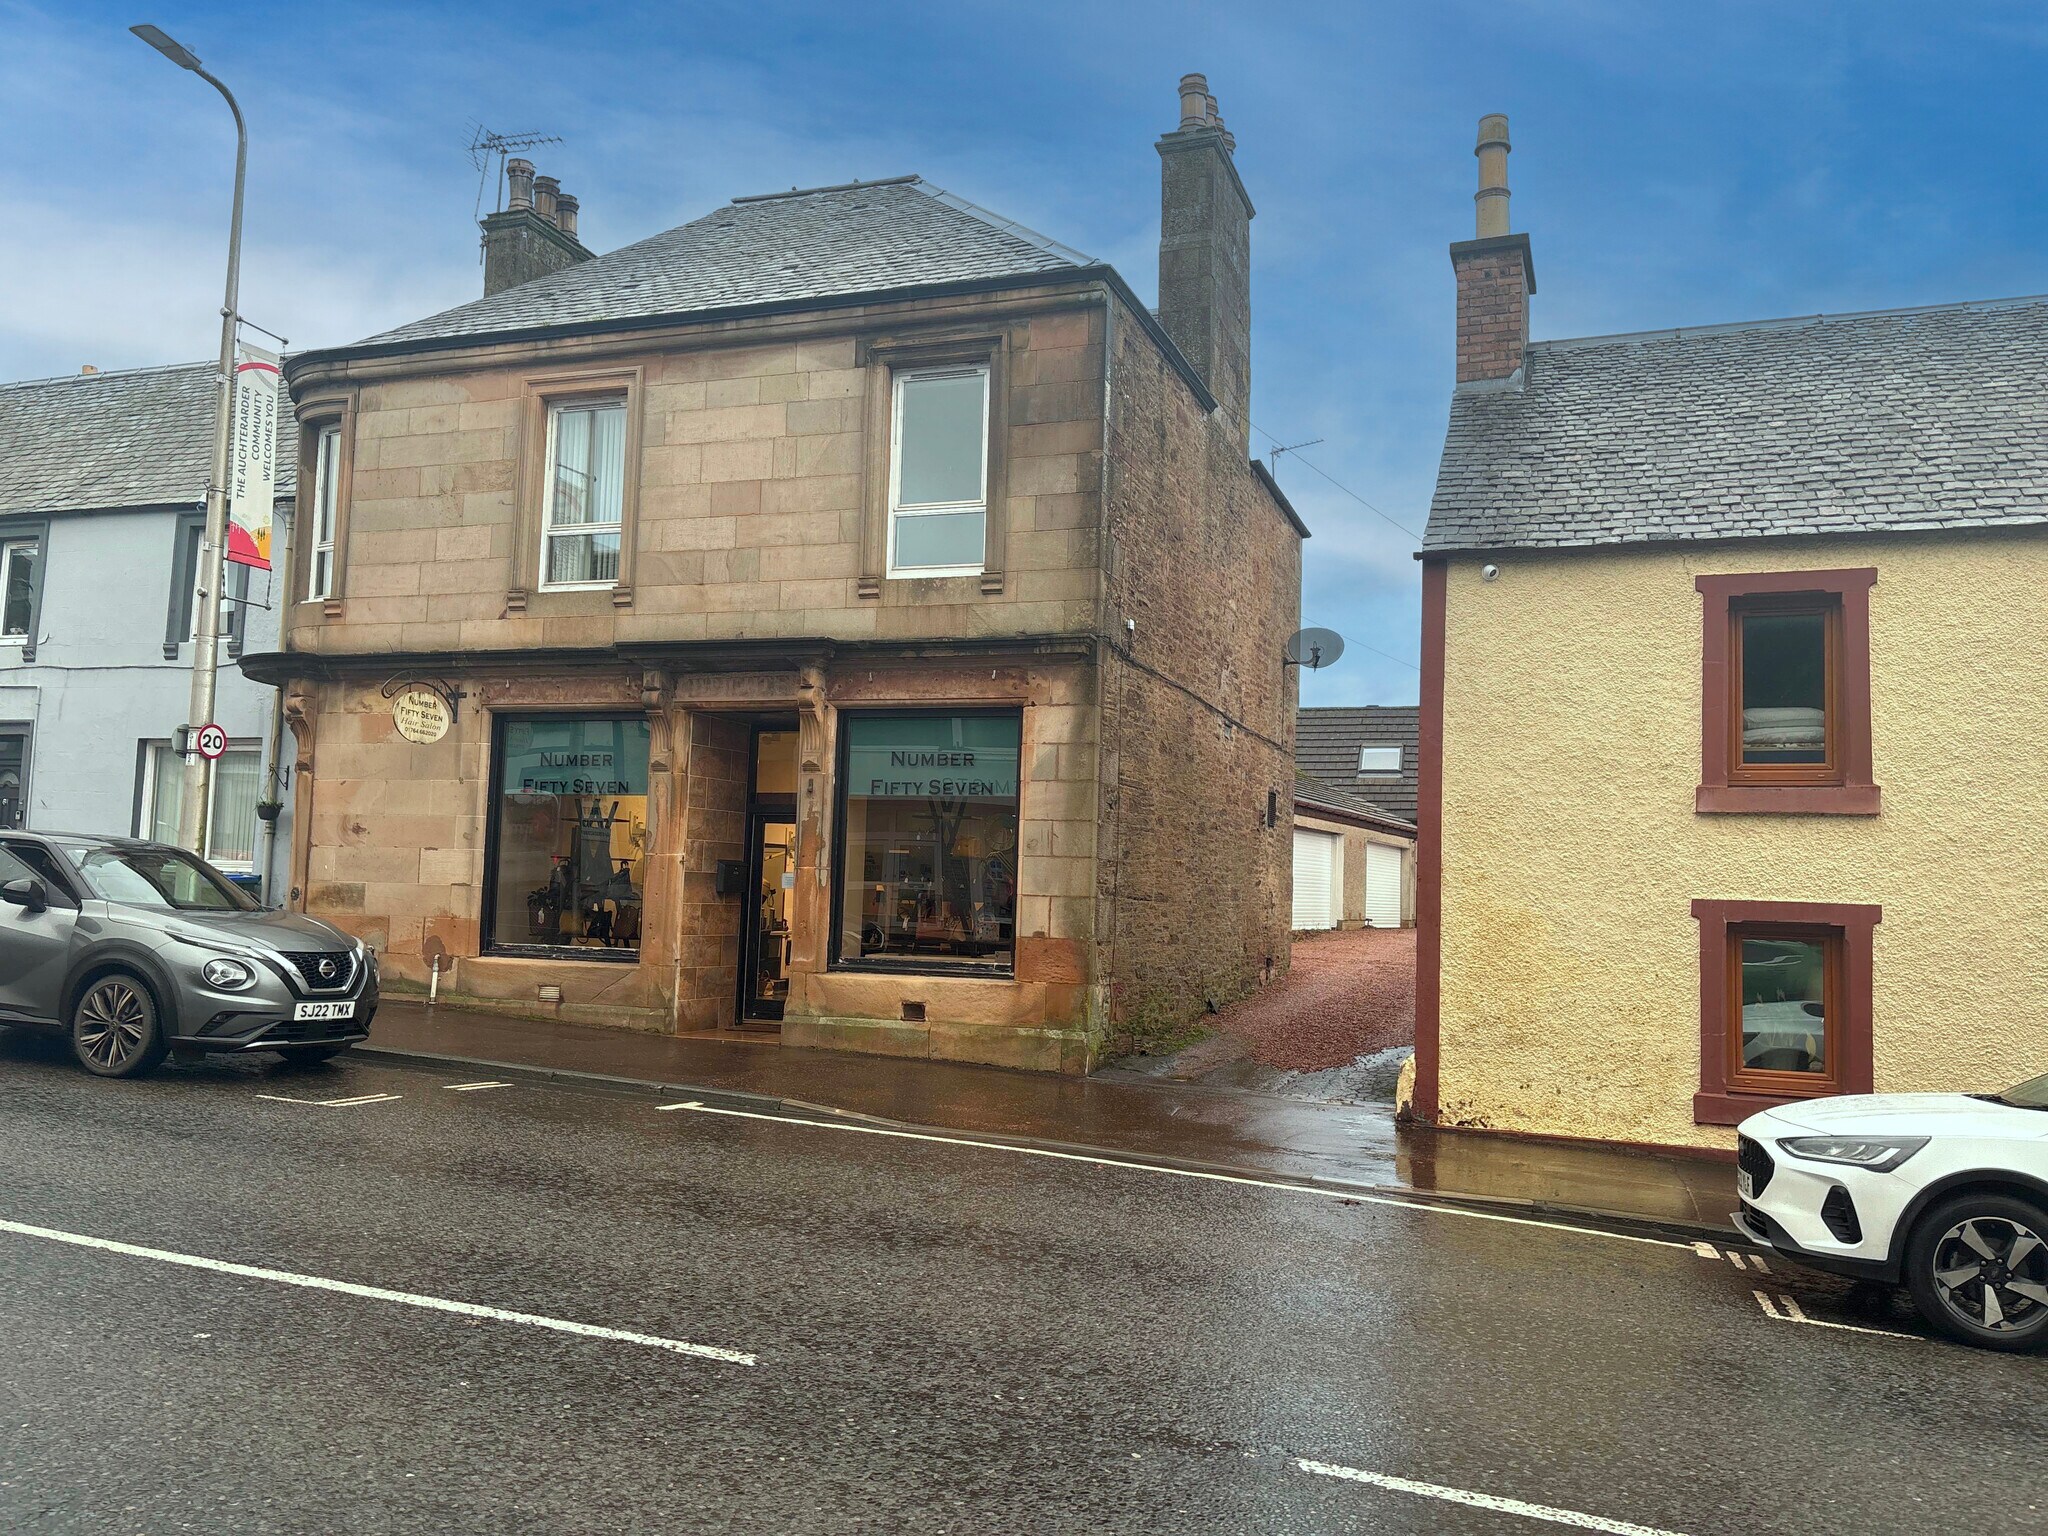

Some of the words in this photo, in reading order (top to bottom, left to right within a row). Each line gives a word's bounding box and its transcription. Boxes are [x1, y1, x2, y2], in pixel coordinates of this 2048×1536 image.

[265, 395, 274, 418] YOU
[238, 386, 250, 476] AUCHTERARDER
[251, 390, 262, 461] COMMUNITY
[263, 420, 274, 482] WELCOMES
[236, 477, 246, 499] THE
[409, 695, 437, 709] NUMBER
[401, 707, 419, 717] FIFTY
[421, 711, 443, 722] SEVEN
[401, 717, 418, 726] Hair
[420, 721, 441, 730] Salon
[202, 734, 223, 750] 20
[540, 752, 613, 767] NUMBER
[891, 751, 975, 767] NUMBER
[523, 779, 568, 793] FIFTY
[573, 778, 629, 794] SEVEN
[871, 779, 923, 795] FIFTY
[928, 779, 994, 796] SEVEN
[300, 1004, 329, 1018] SJ22
[332, 1003, 351, 1017] TMX
